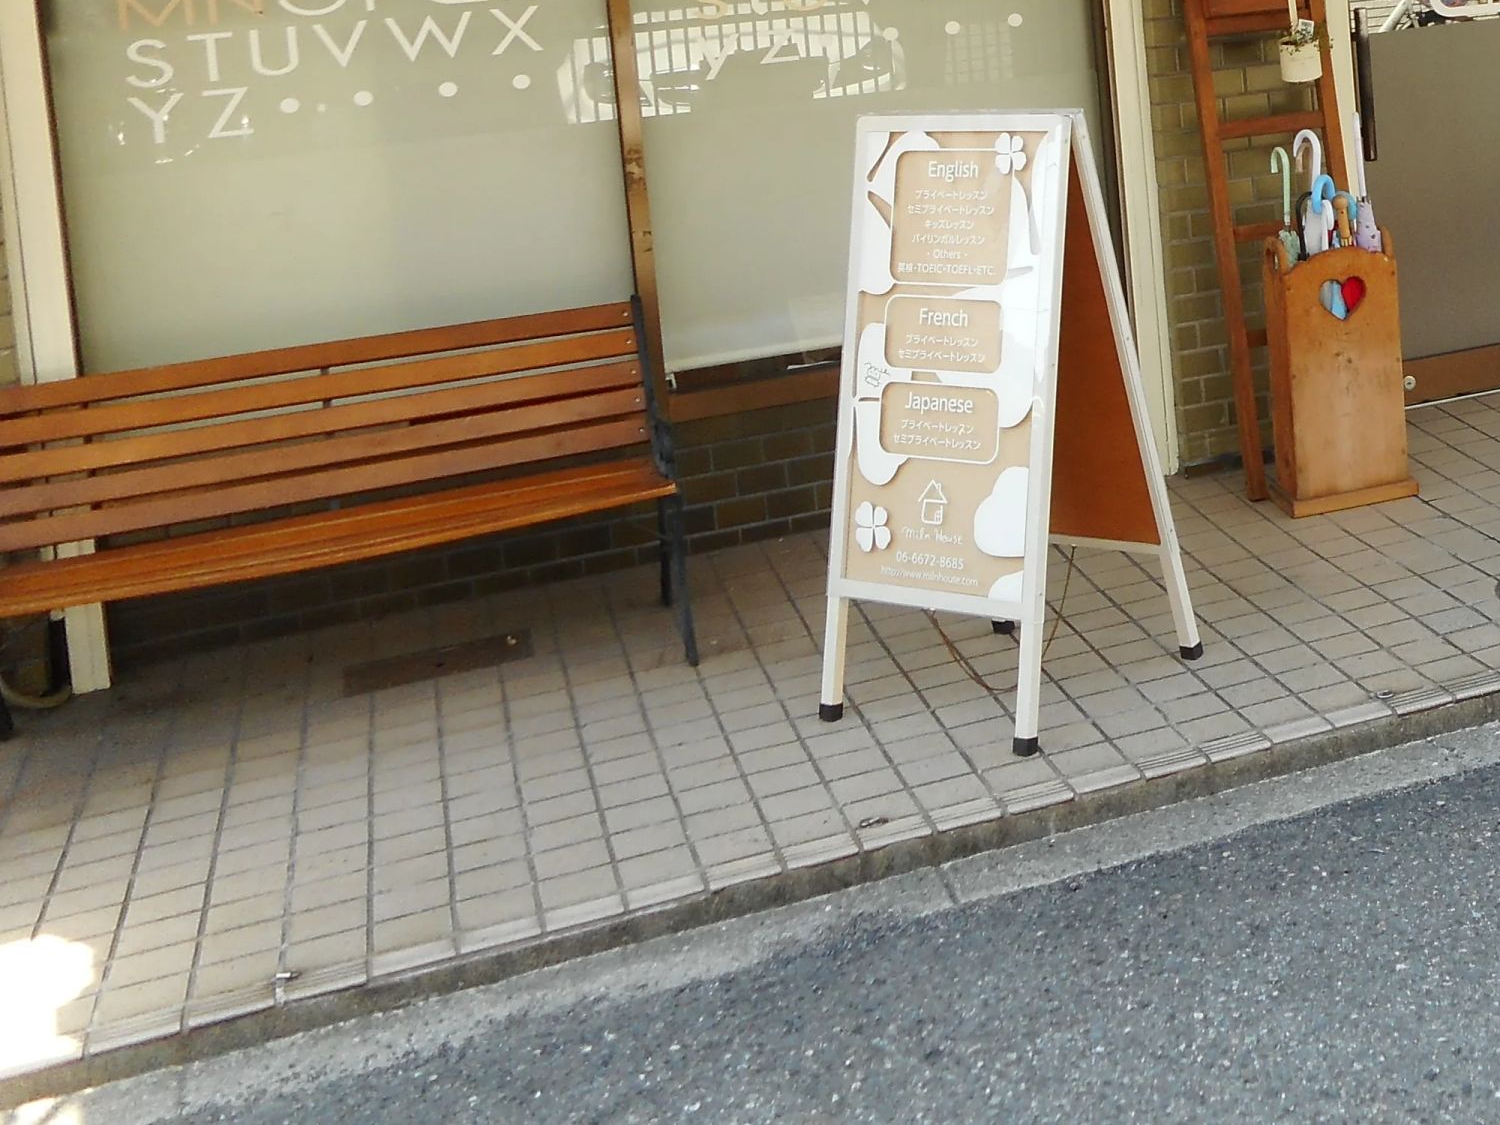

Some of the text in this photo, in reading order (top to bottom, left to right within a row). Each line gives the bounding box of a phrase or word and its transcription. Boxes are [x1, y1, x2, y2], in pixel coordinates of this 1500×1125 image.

[928, 160, 979, 183] English
[915, 189, 988, 201] プライベートレッスン
[907, 204, 995, 216] セミプライベートレッスン
[925, 219, 975, 230] キッズレッスン
[919, 307, 969, 328] French
[905, 333, 979, 348] プライベートレッスン
[898, 348, 986, 363] セミプライベートレッスン
[905, 392, 974, 414] Japanese
[901, 418, 974, 435] プライベートレッスン
[893, 433, 981, 450] セミプライベートレッスン
[895, 550, 964, 570] 06-6672-8685
